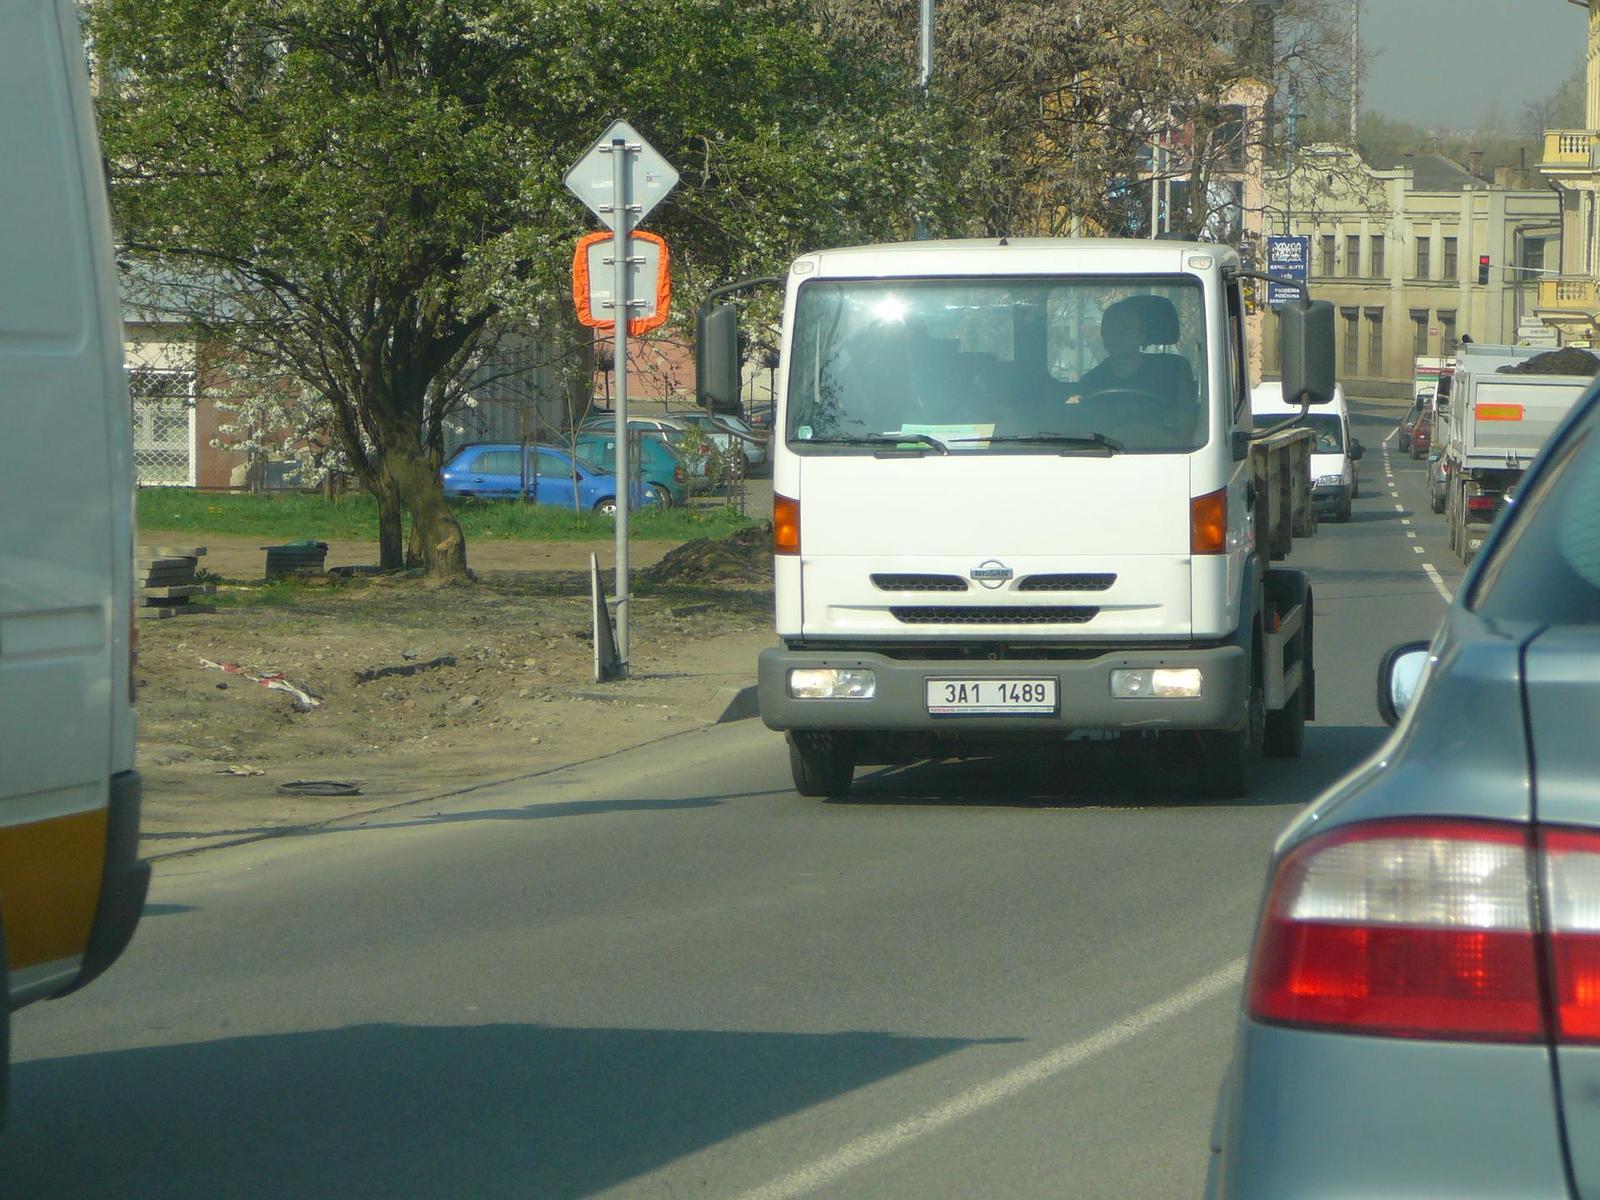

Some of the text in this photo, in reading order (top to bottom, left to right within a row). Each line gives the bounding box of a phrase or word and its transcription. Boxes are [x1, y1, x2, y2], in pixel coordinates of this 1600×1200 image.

[974, 569, 1009, 577] NISSAN
[945, 683, 1045, 703] 3A1 1489
